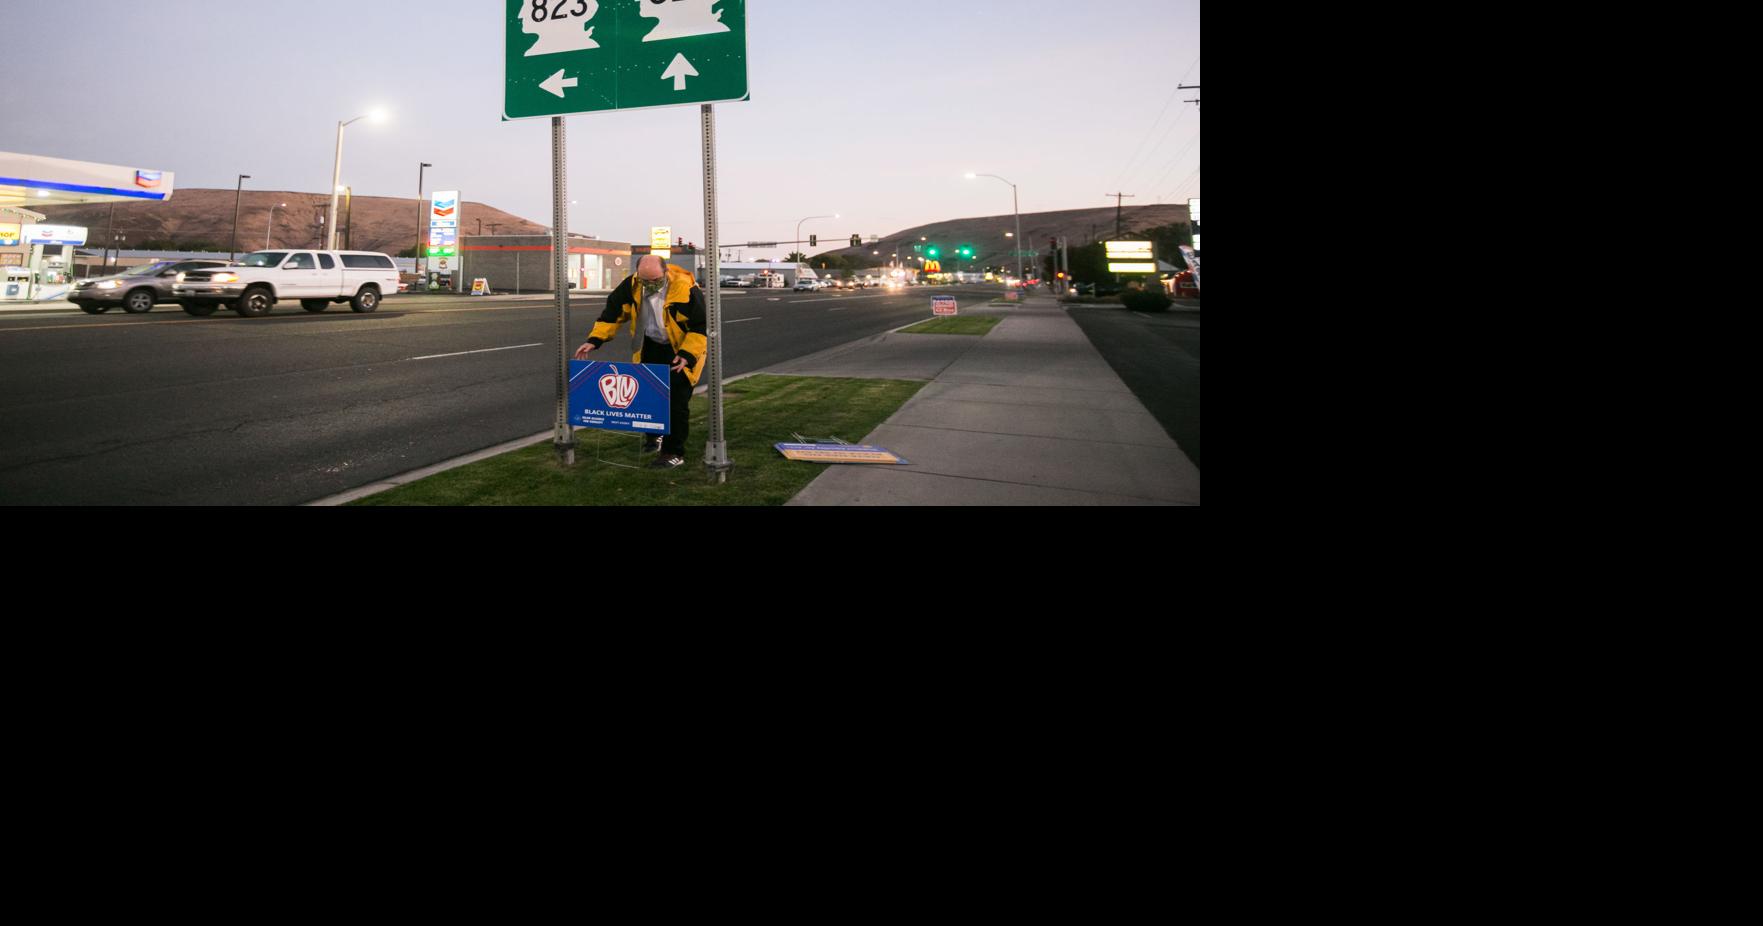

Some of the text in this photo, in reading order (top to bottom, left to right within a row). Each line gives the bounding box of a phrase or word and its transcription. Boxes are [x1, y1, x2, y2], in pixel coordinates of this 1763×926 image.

[531, 0, 588, 22] 823
[600, 373, 636, 406] BLM
[624, 412, 652, 420] MATTER
